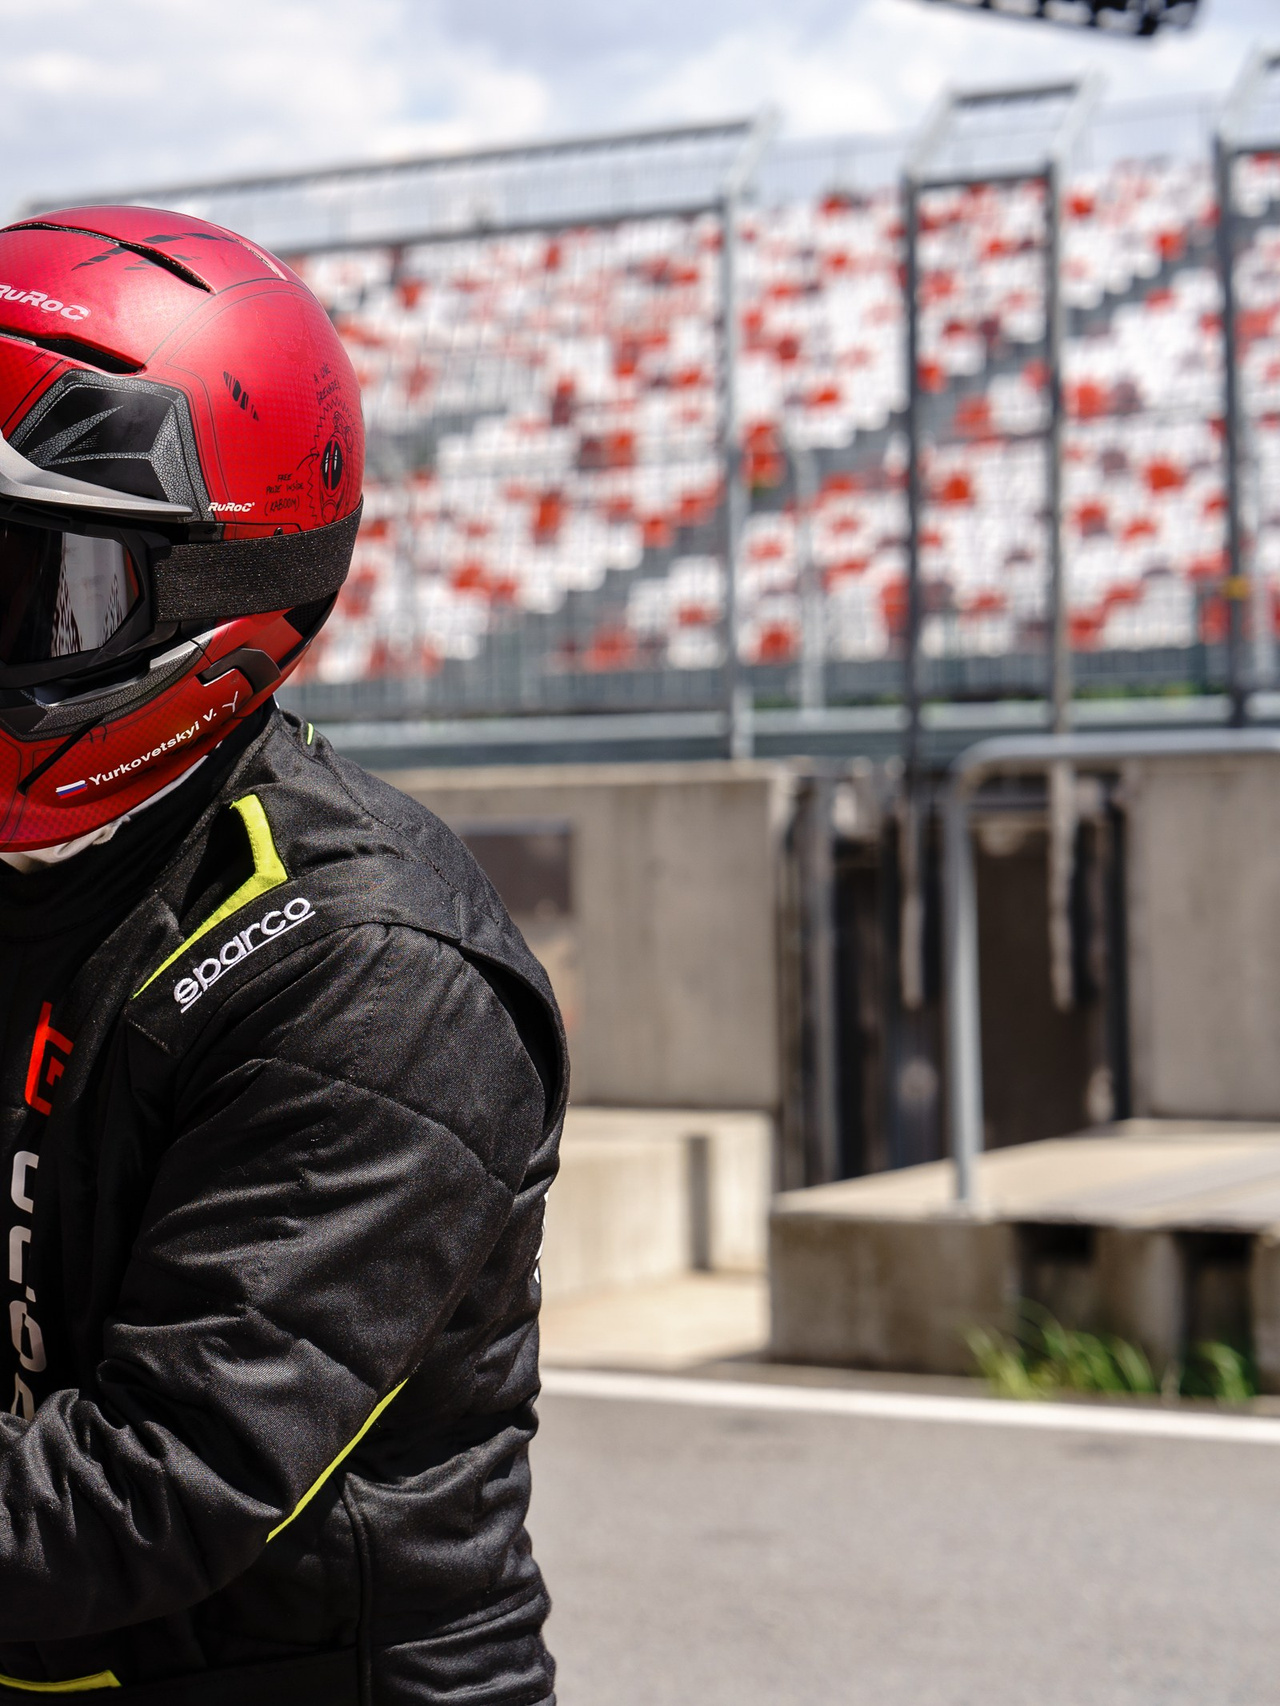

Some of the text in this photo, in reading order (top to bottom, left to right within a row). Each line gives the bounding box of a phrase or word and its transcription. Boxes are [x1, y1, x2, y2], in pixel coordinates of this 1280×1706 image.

[89, 708, 217, 786] Yurkovetskyi V.
[174, 898, 314, 1006] sparco
